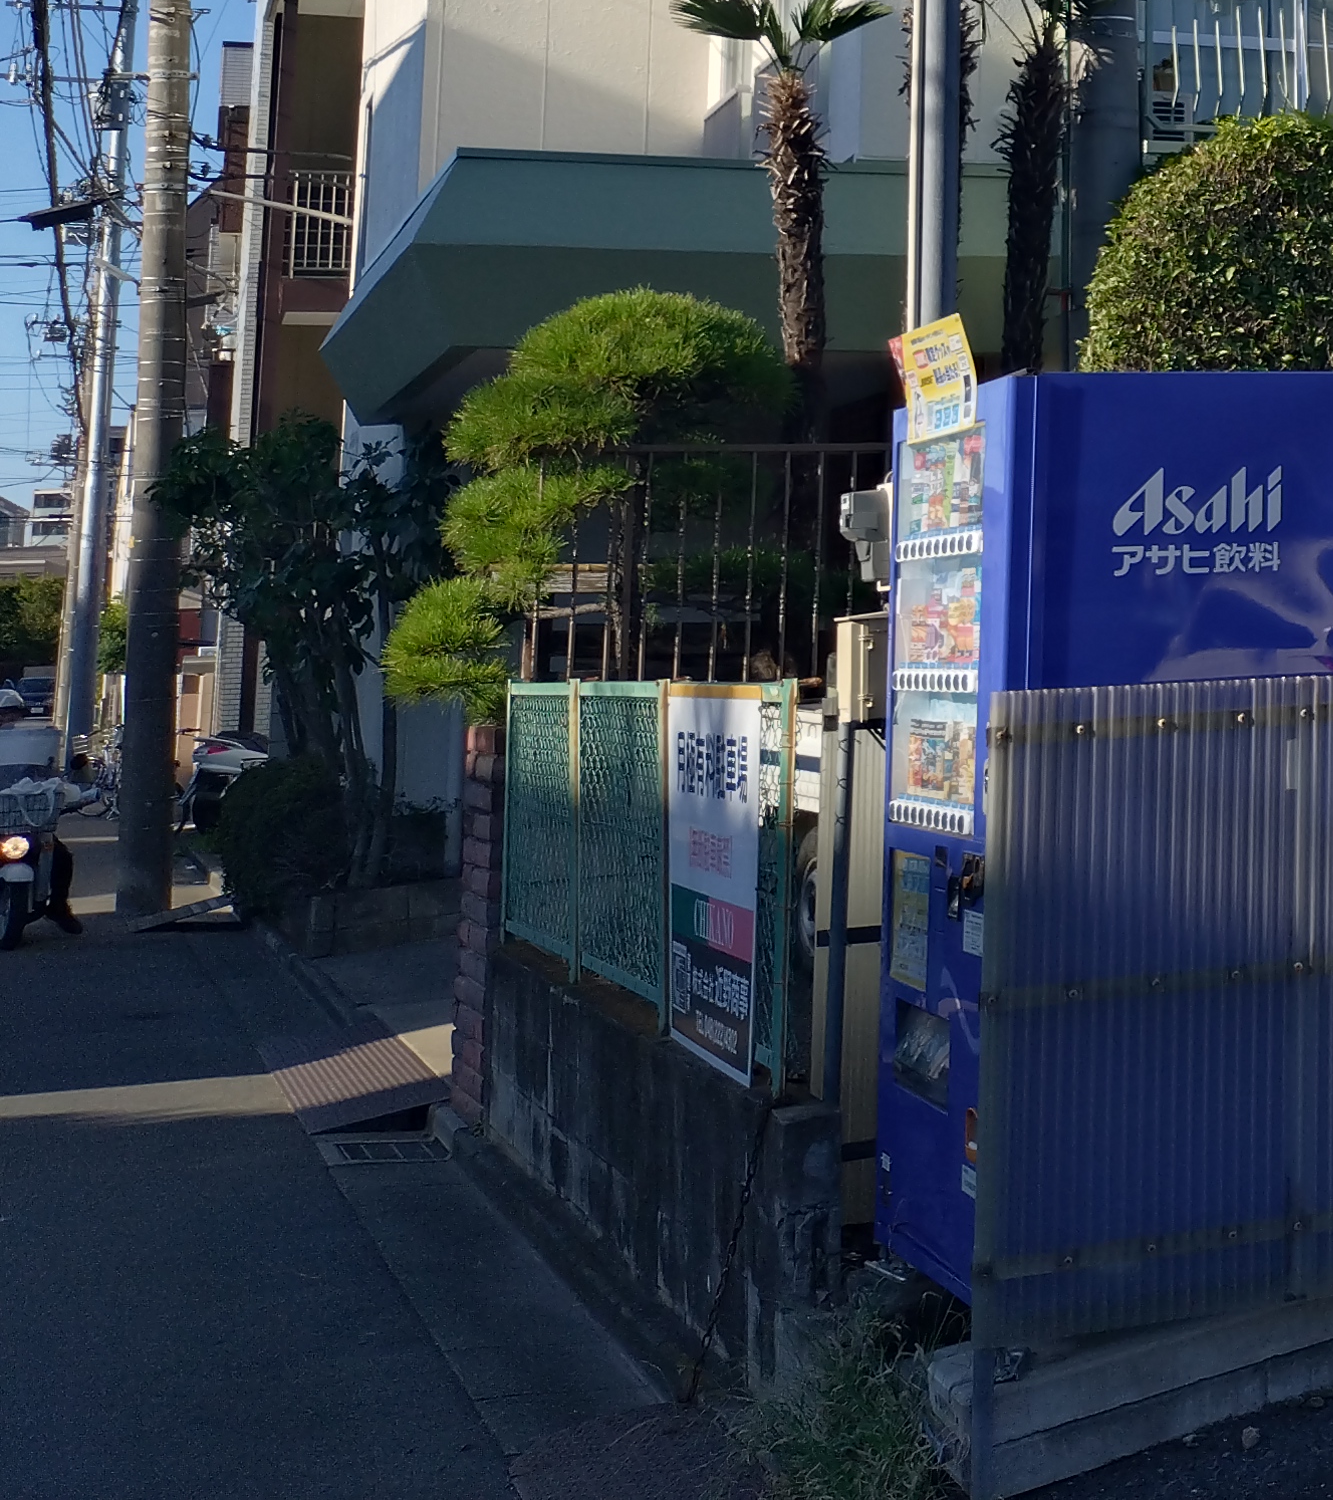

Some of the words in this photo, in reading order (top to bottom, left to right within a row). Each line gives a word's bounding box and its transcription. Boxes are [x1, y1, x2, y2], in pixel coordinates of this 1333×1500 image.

[1112, 465, 1282, 536] Asahi
[1111, 541, 1281, 577] アサヒ飲料
